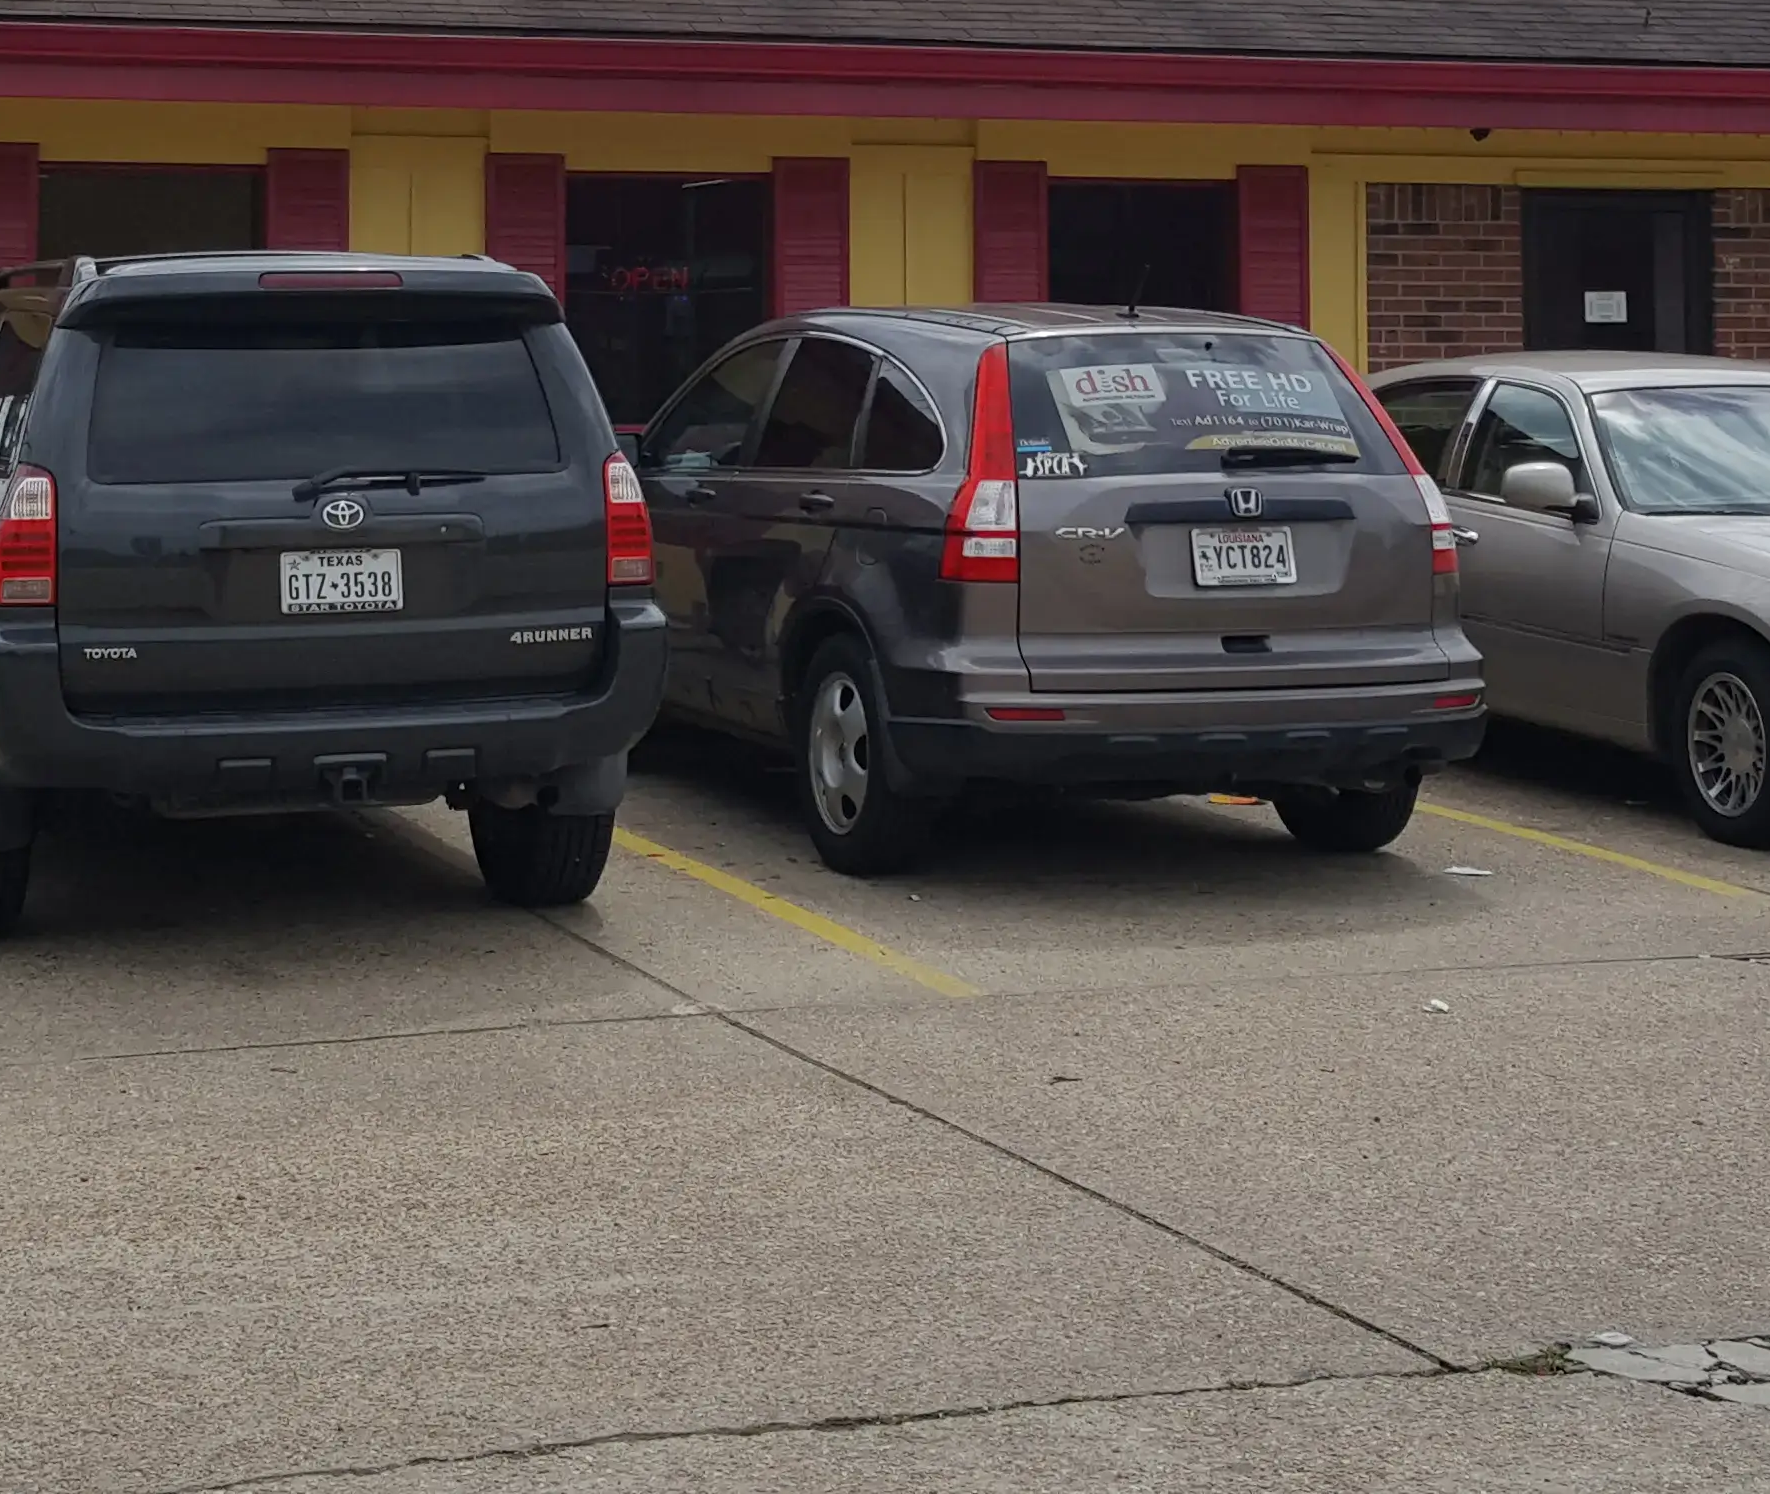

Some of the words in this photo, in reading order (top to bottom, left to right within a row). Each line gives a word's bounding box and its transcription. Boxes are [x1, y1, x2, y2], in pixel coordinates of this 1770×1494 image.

[610, 266, 690, 291] OPEN
[1075, 368, 1154, 395] dish
[1185, 369, 1264, 391] FREE
[1267, 371, 1312, 393] HD
[1216, 390, 1251, 407] For
[1261, 391, 1300, 409] Life
[1194, 415, 1244, 426] Ad1164
[1035, 453, 1071, 475] SPCA
[1055, 527, 1125, 539] CR-V
[1217, 533, 1264, 544] LOUISIANA
[317, 555, 363, 567] TEXAS
[1213, 544, 1287, 569] YCT824
[334, 601, 398, 611] TOYOTA
[510, 627, 594, 644] 4RUNNER
[84, 647, 138, 660] TOYOTA
